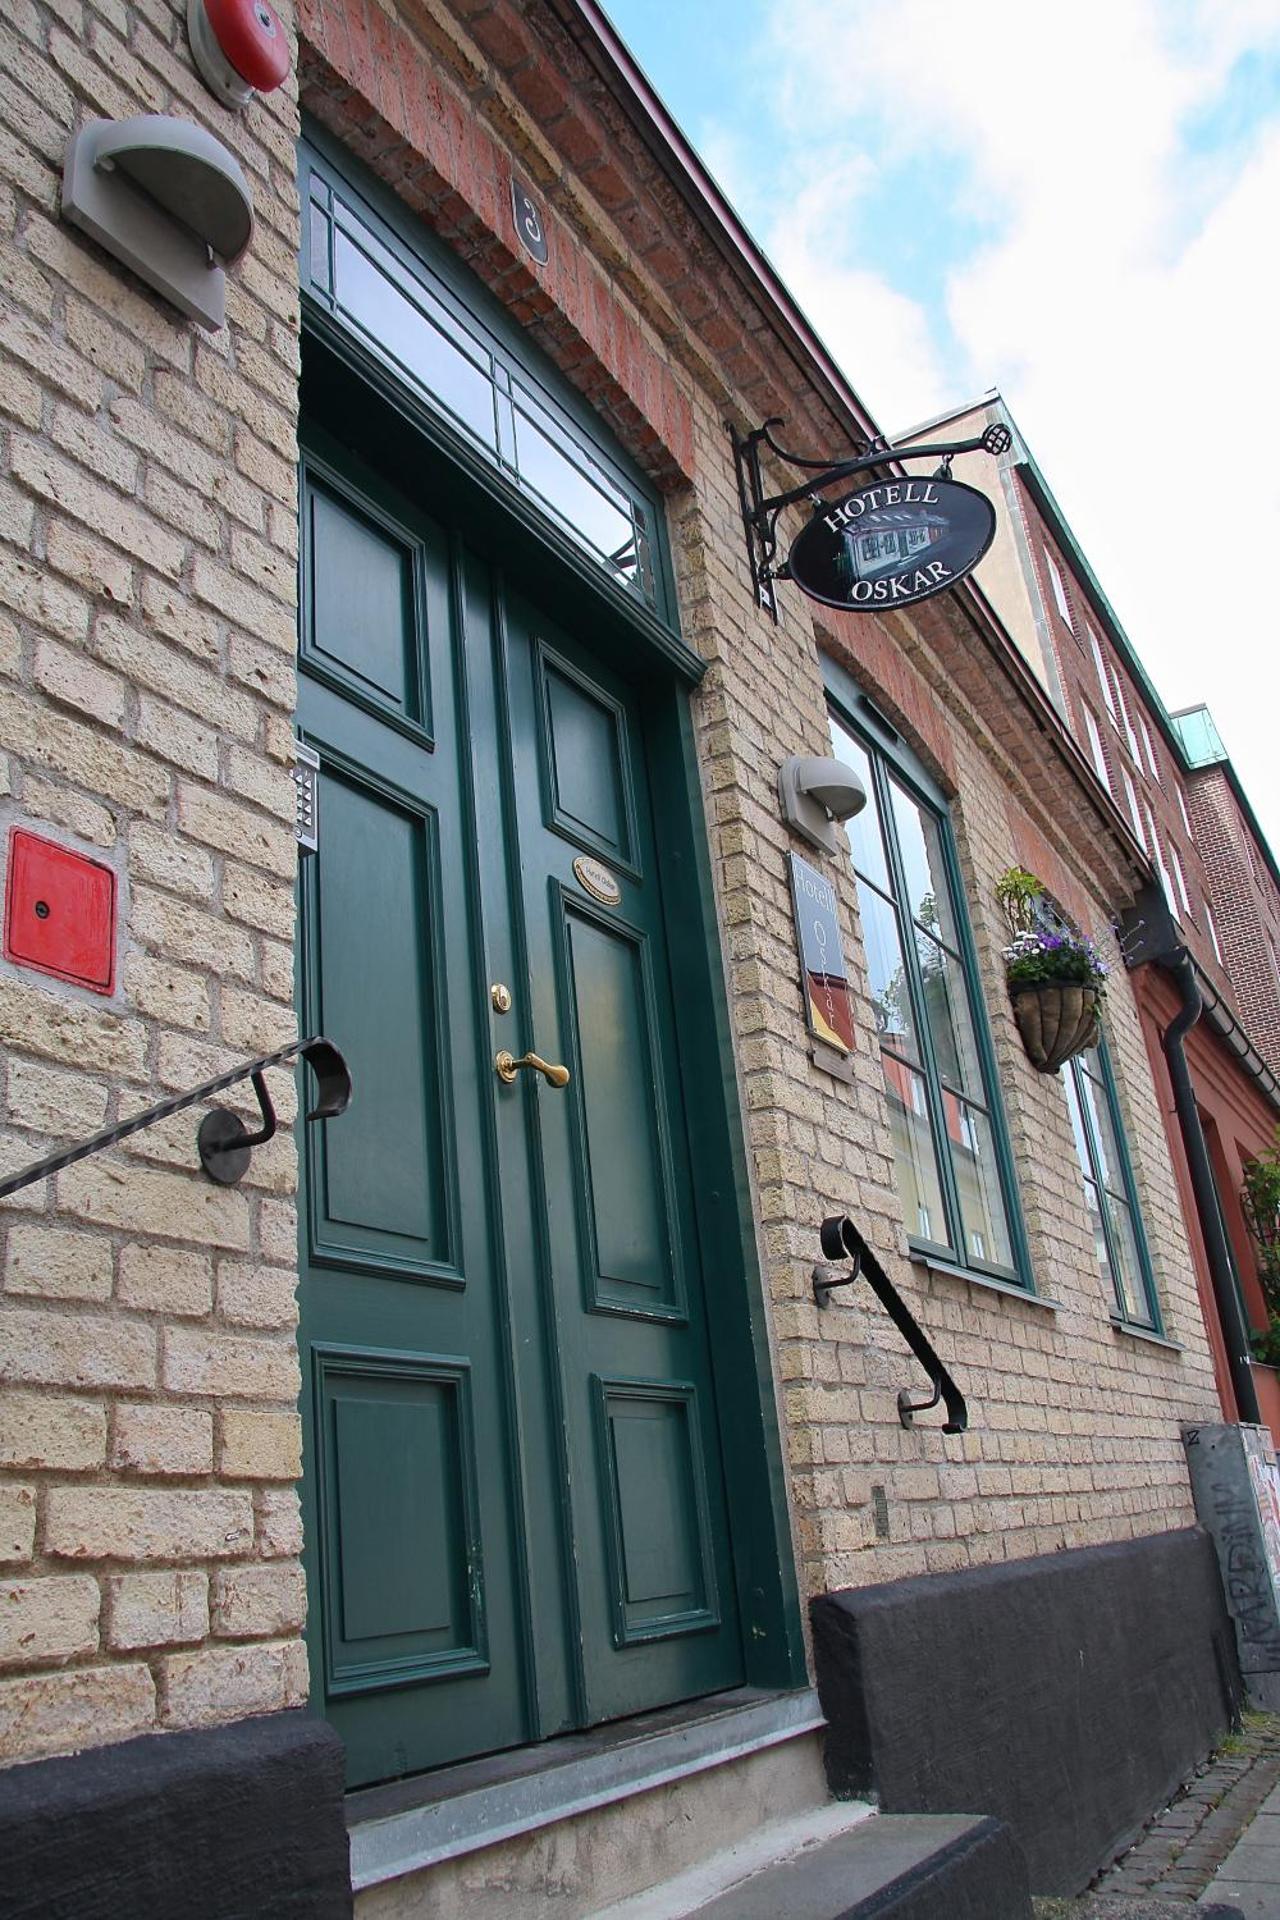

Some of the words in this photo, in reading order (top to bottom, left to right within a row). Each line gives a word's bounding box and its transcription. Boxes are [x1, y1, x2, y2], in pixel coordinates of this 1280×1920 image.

[523, 198, 541, 242] 3
[822, 483, 941, 534] HOTELL
[851, 560, 952, 601] OSKAR
[795, 867, 834, 912] Hotell
[813, 920, 836, 1030] Oskar
